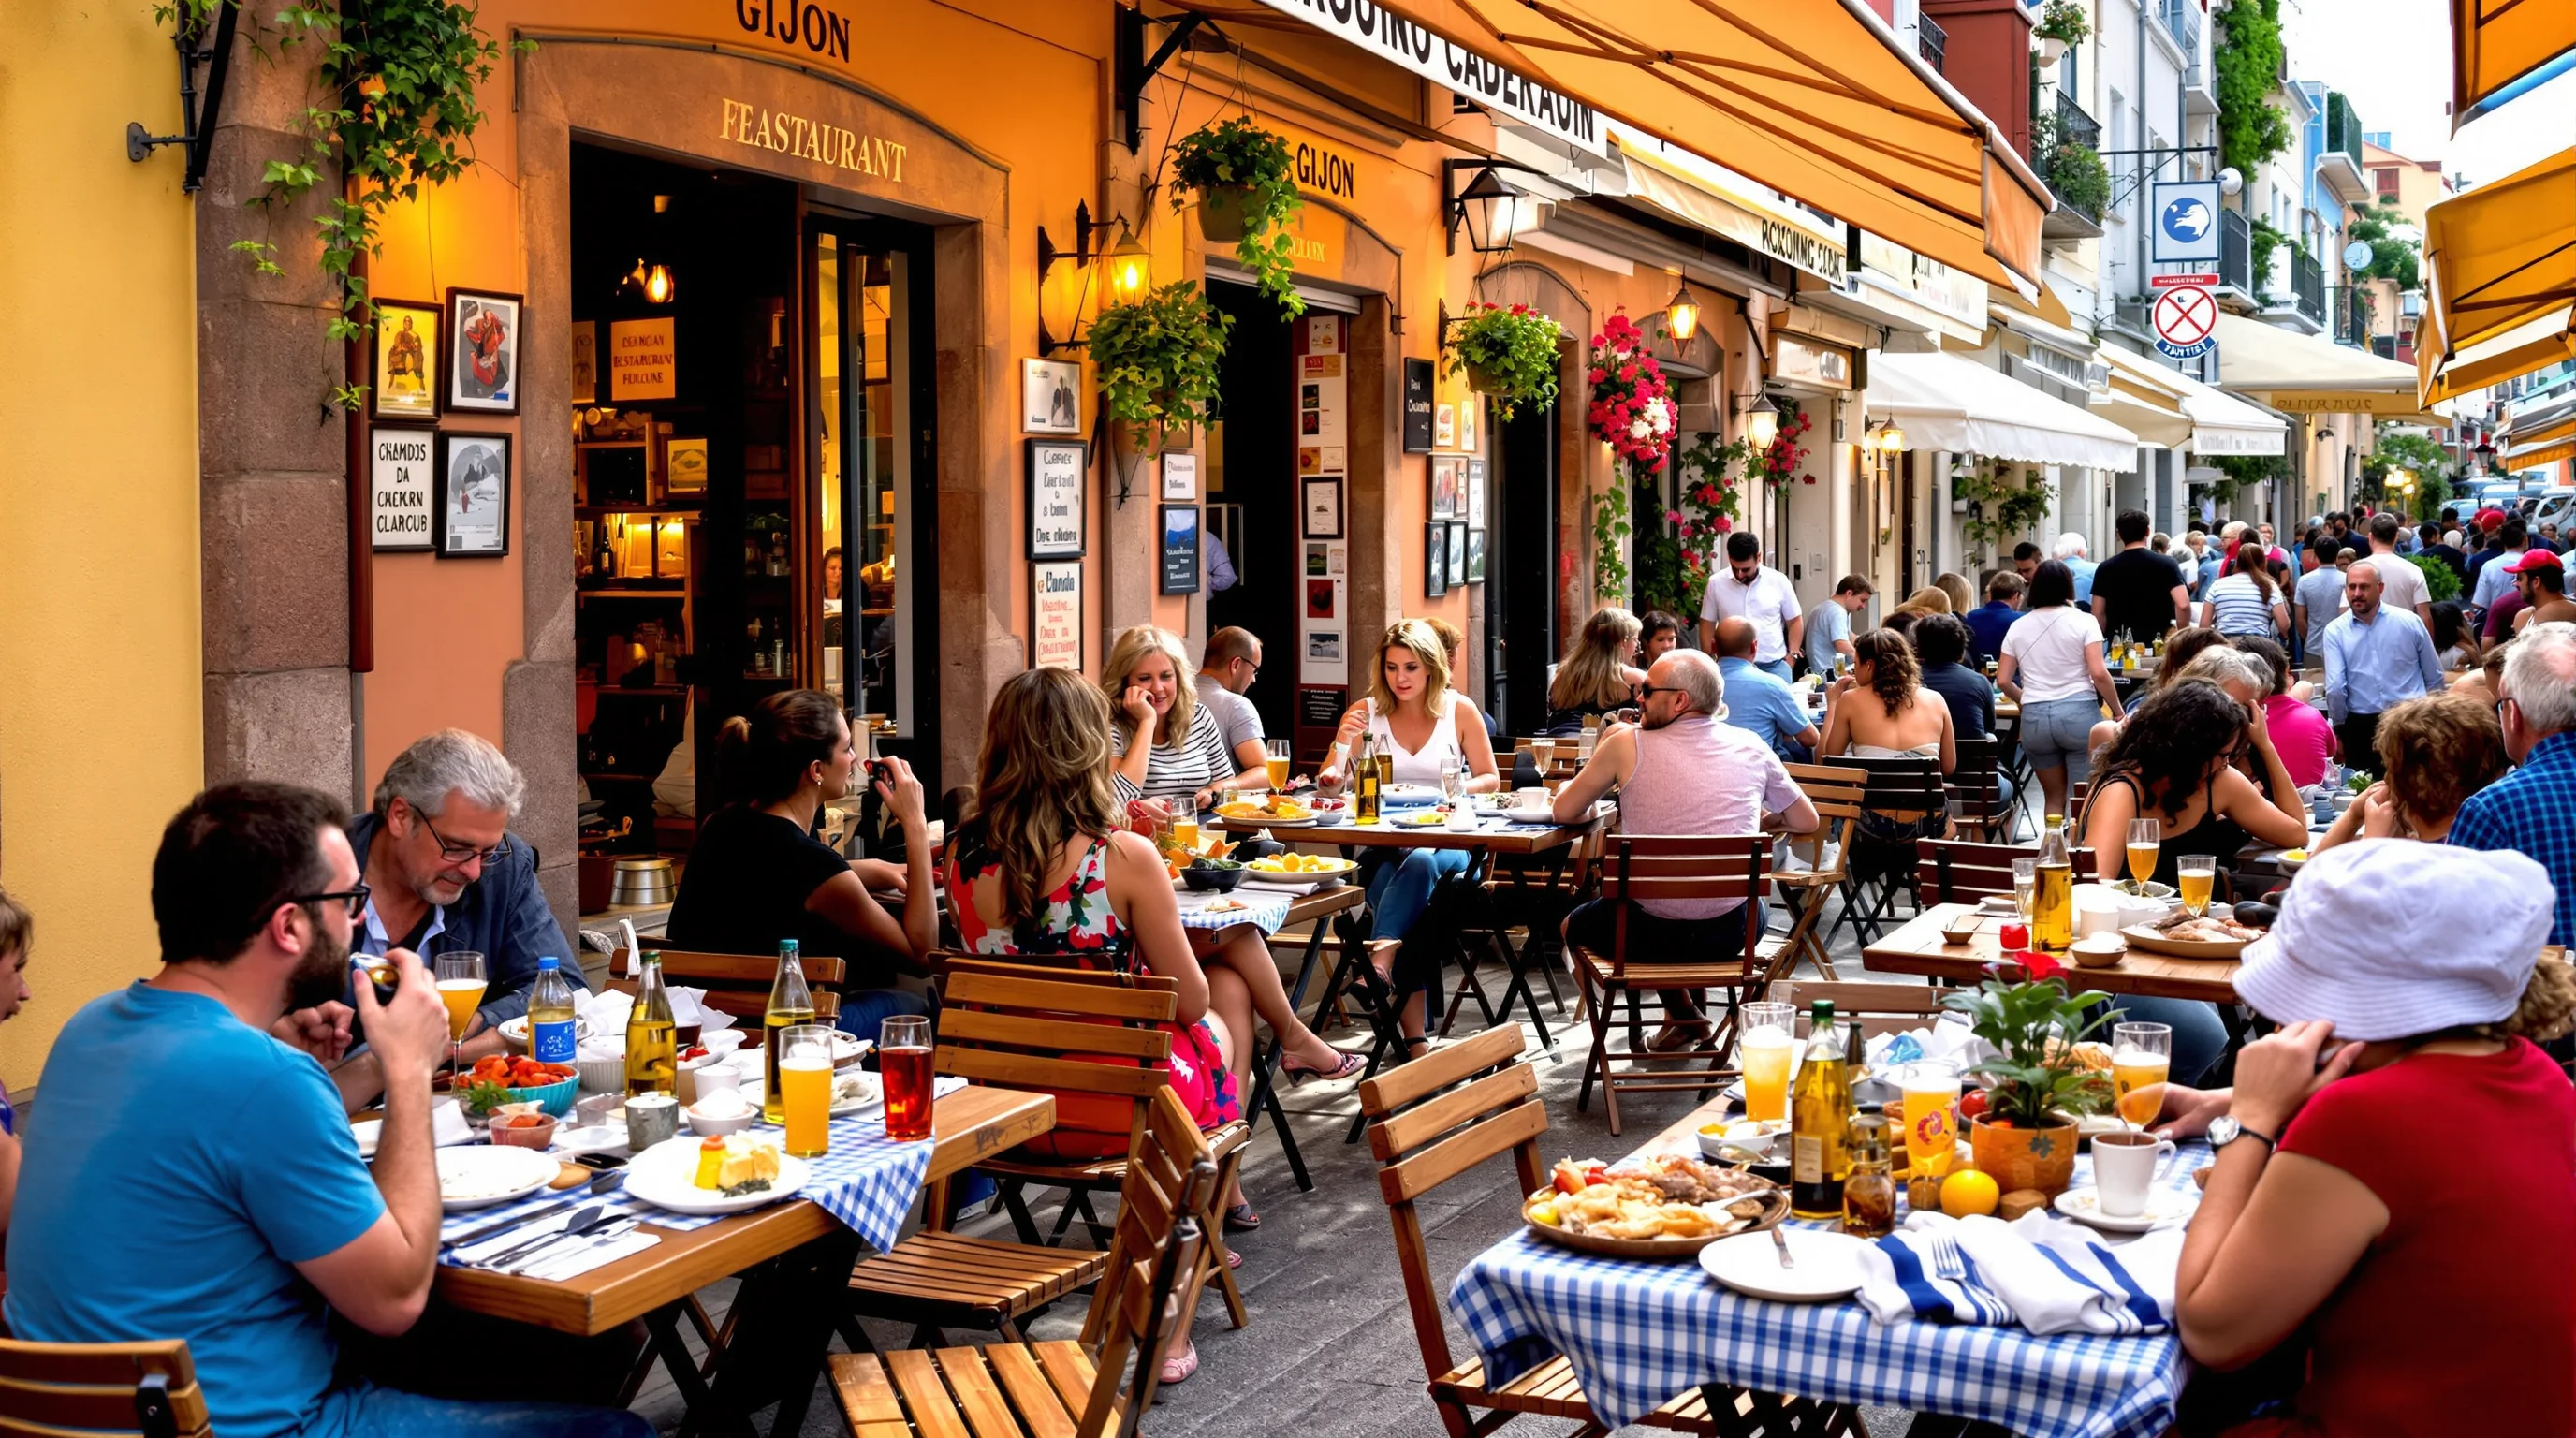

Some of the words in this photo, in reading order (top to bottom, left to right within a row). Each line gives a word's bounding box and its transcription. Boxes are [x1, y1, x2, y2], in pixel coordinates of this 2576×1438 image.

[736, 0, 851, 63] GIJON
[1297, 143, 1354, 199] GIJON
[396, 466, 410, 483] DA
